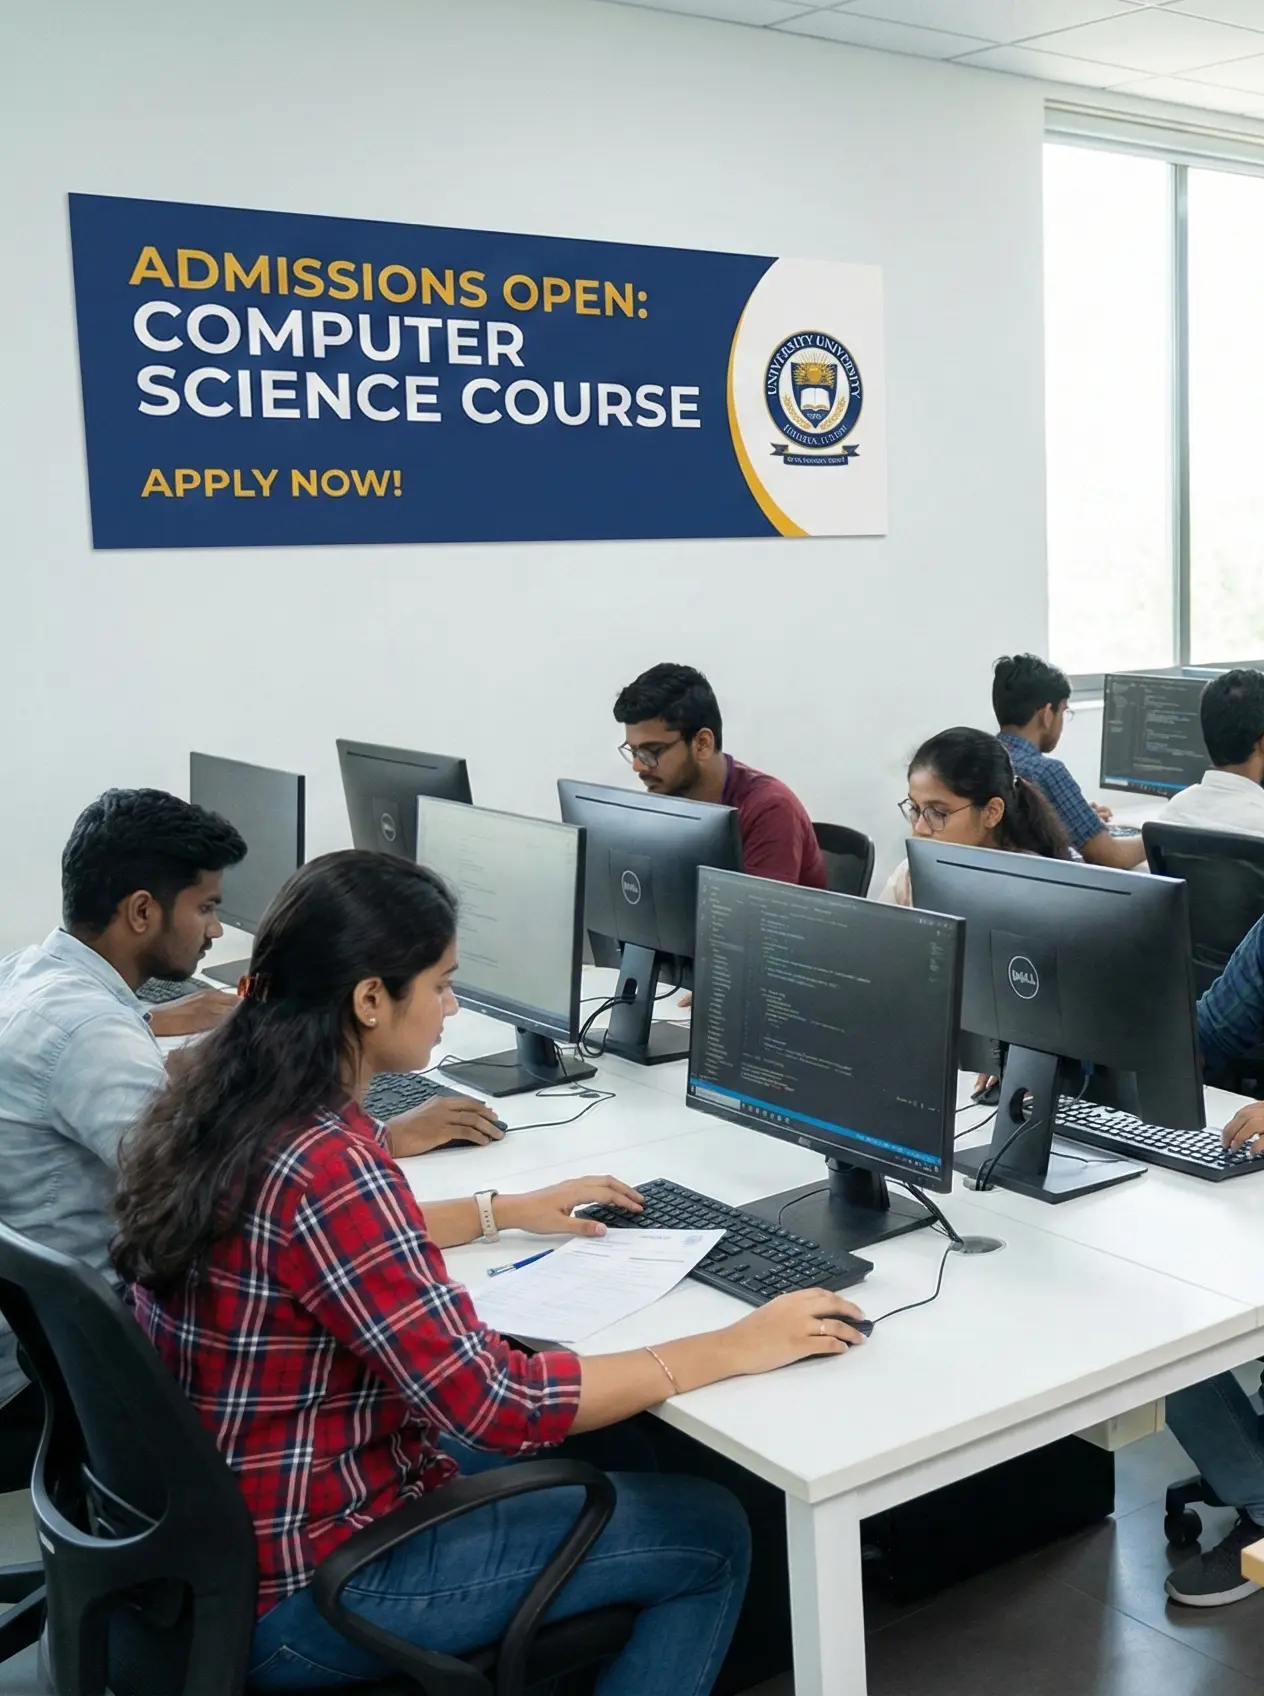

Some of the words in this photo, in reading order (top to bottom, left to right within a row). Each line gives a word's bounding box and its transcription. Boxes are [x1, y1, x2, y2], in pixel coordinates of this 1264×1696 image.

[129, 245, 488, 309] ADMISSIONS
[502, 273, 650, 319] OPEN:
[133, 300, 525, 367] COMPUTER
[137, 365, 442, 423] SCIENCE
[461, 378, 702, 428] COURSE
[141, 468, 278, 498] APPLY
[290, 468, 402, 498] NOW!
